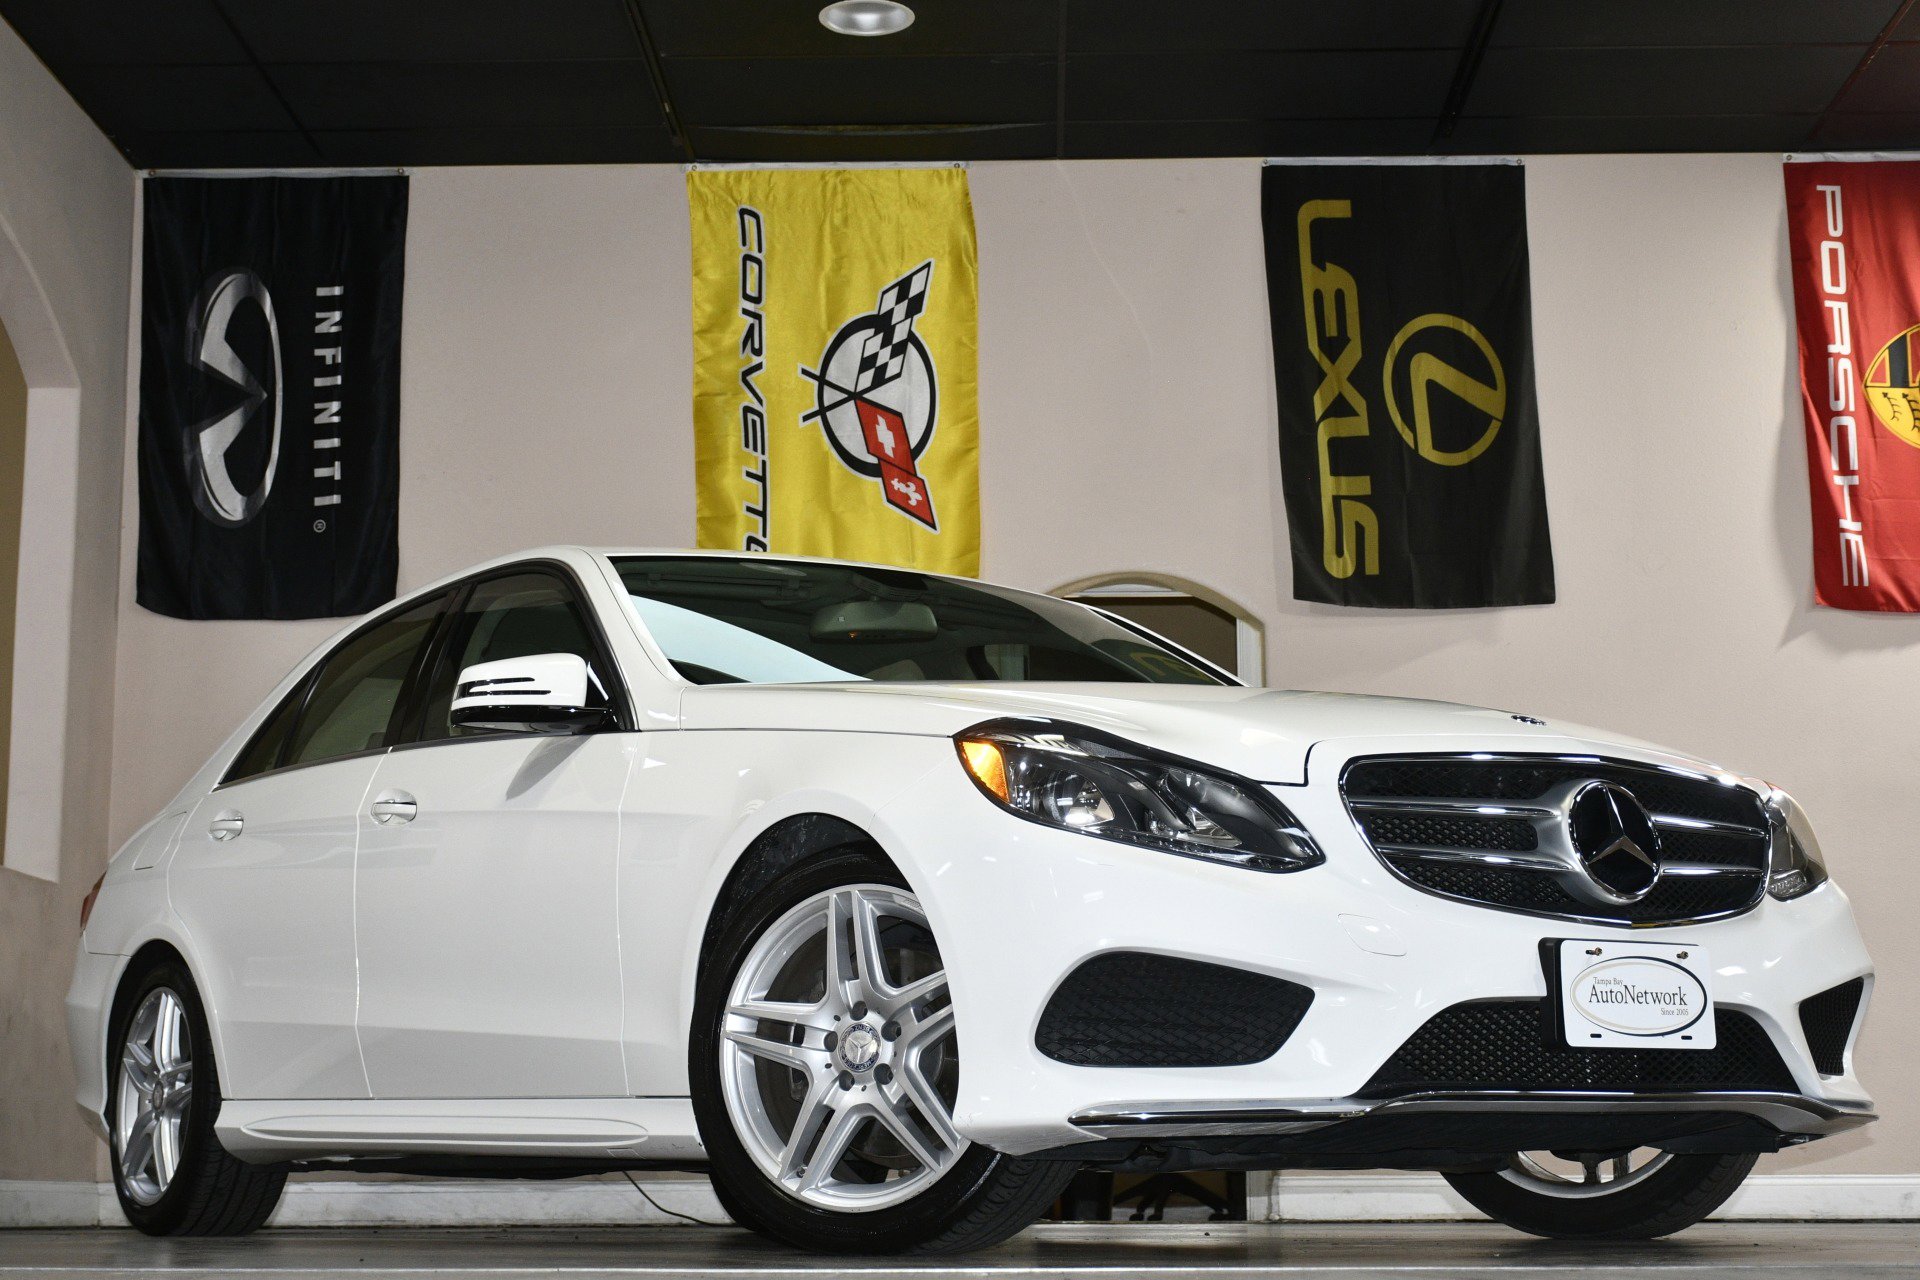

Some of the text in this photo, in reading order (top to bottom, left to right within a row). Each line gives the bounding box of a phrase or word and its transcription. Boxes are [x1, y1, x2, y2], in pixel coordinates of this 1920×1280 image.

[314, 286, 344, 506] INFINITI
[1297, 199, 1381, 579] LEXUS
[1816, 185, 1869, 587] PORSCHE
[1588, 984, 1688, 1006] AutoNetwork
[1593, 977, 1624, 987] Tampa Bay
[1660, 1007, 1675, 1016] Since
